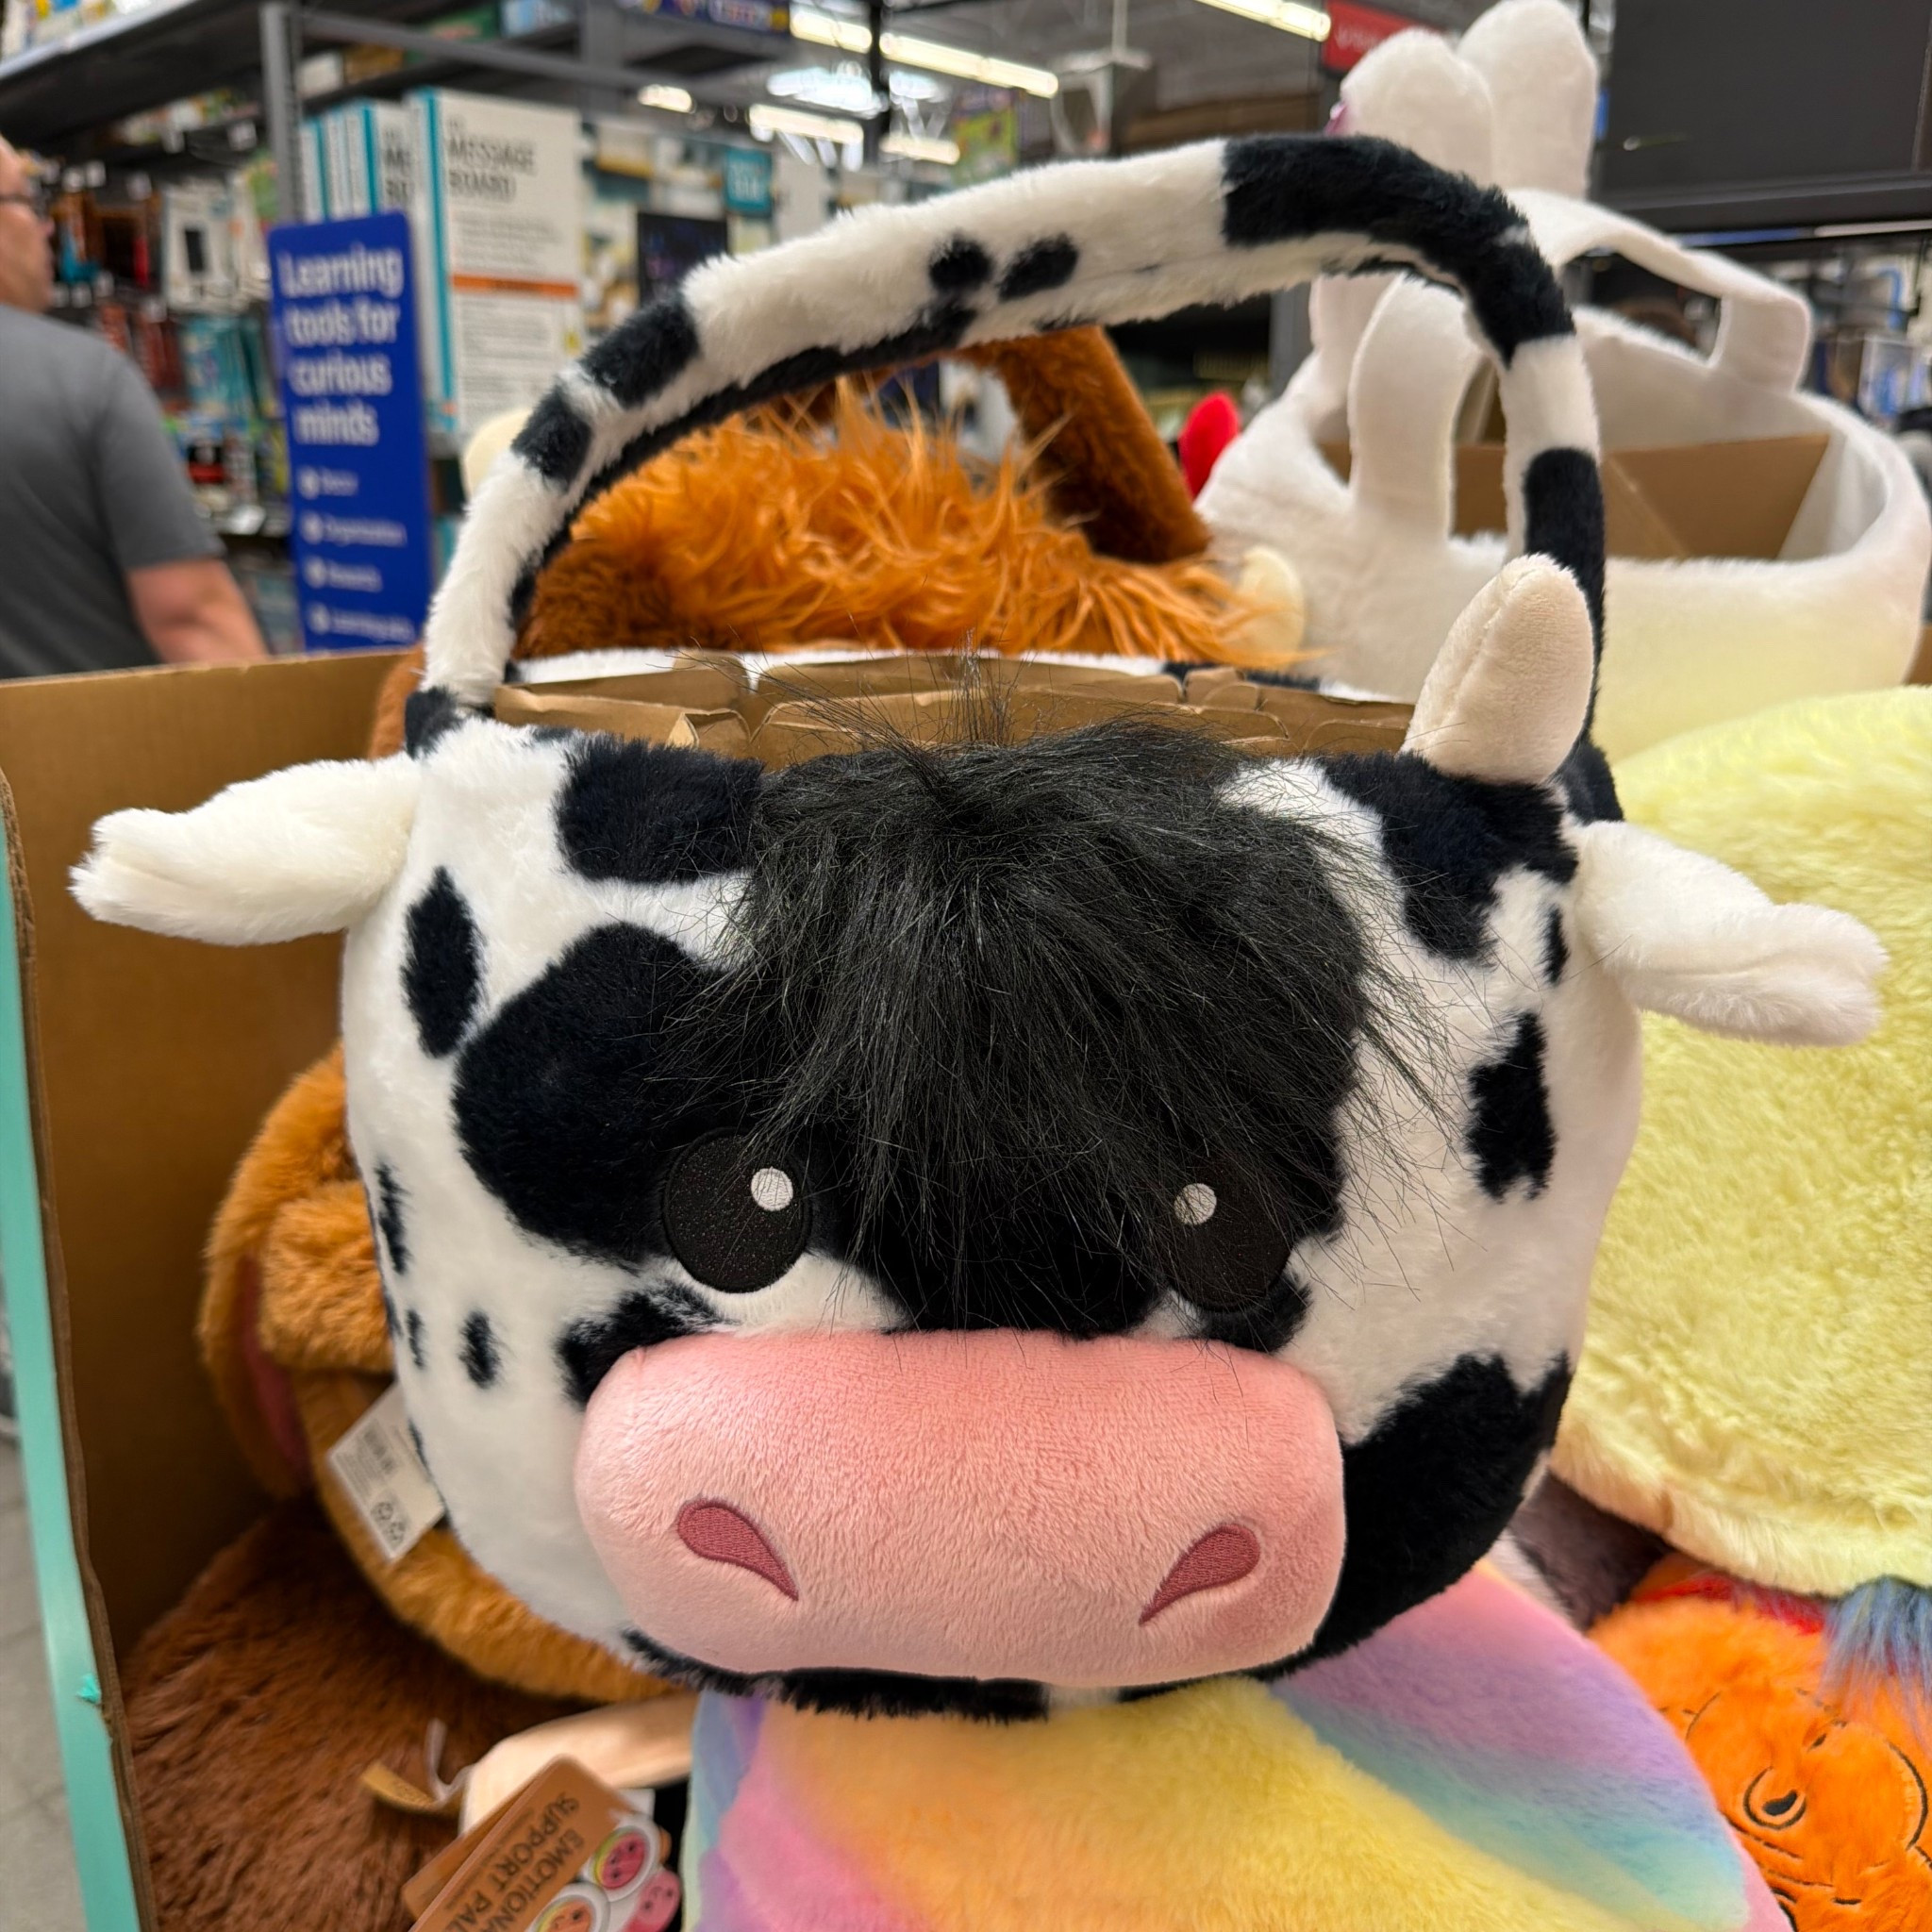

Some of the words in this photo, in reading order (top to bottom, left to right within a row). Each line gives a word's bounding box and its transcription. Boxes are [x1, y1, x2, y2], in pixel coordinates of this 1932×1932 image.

[277, 242, 404, 298] Learning
[287, 298, 354, 347] tools
[355, 295, 400, 344] for
[290, 349, 392, 396] curious
[293, 398, 379, 446] minds
[489, 1793, 580, 1890] SUPPORT
